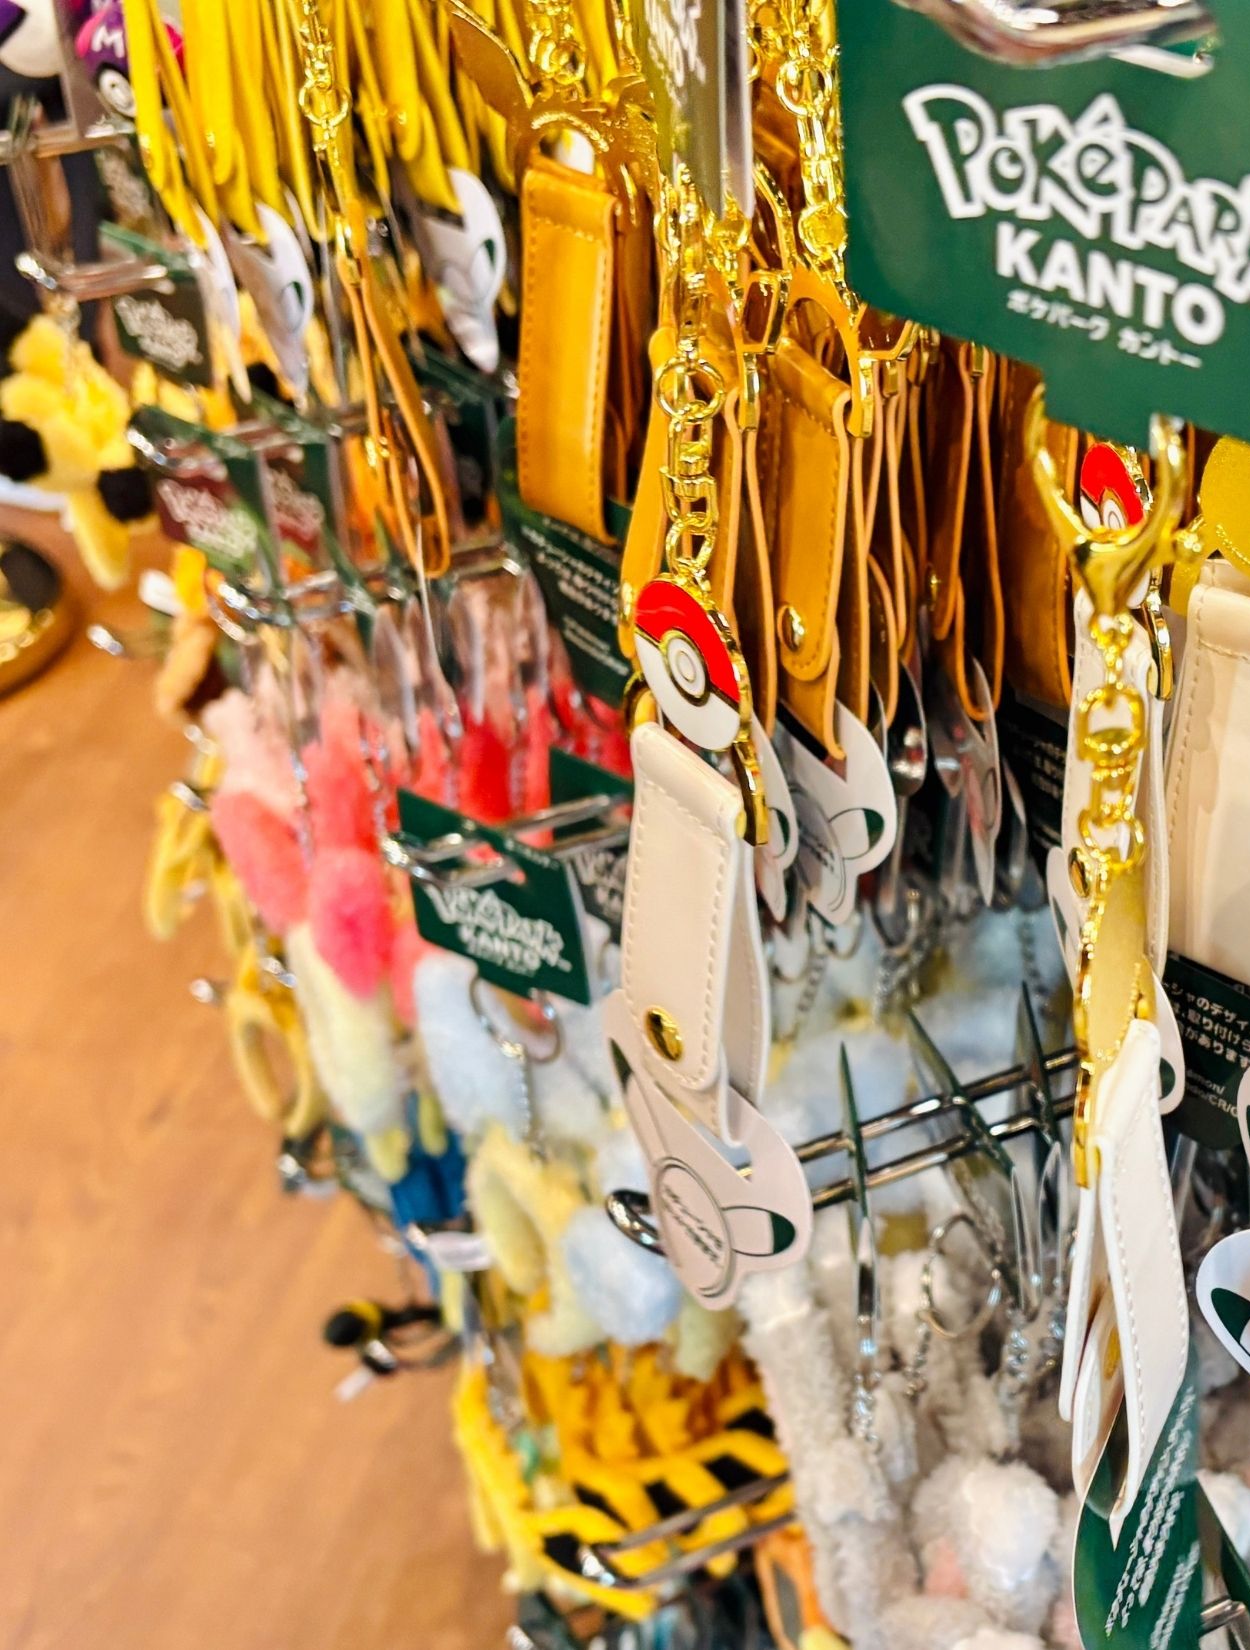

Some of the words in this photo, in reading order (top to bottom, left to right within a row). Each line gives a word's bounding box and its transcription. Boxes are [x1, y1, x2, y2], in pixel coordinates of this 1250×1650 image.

[996, 222, 1225, 345] KANTO
[1117, 326, 1202, 369] カントー
